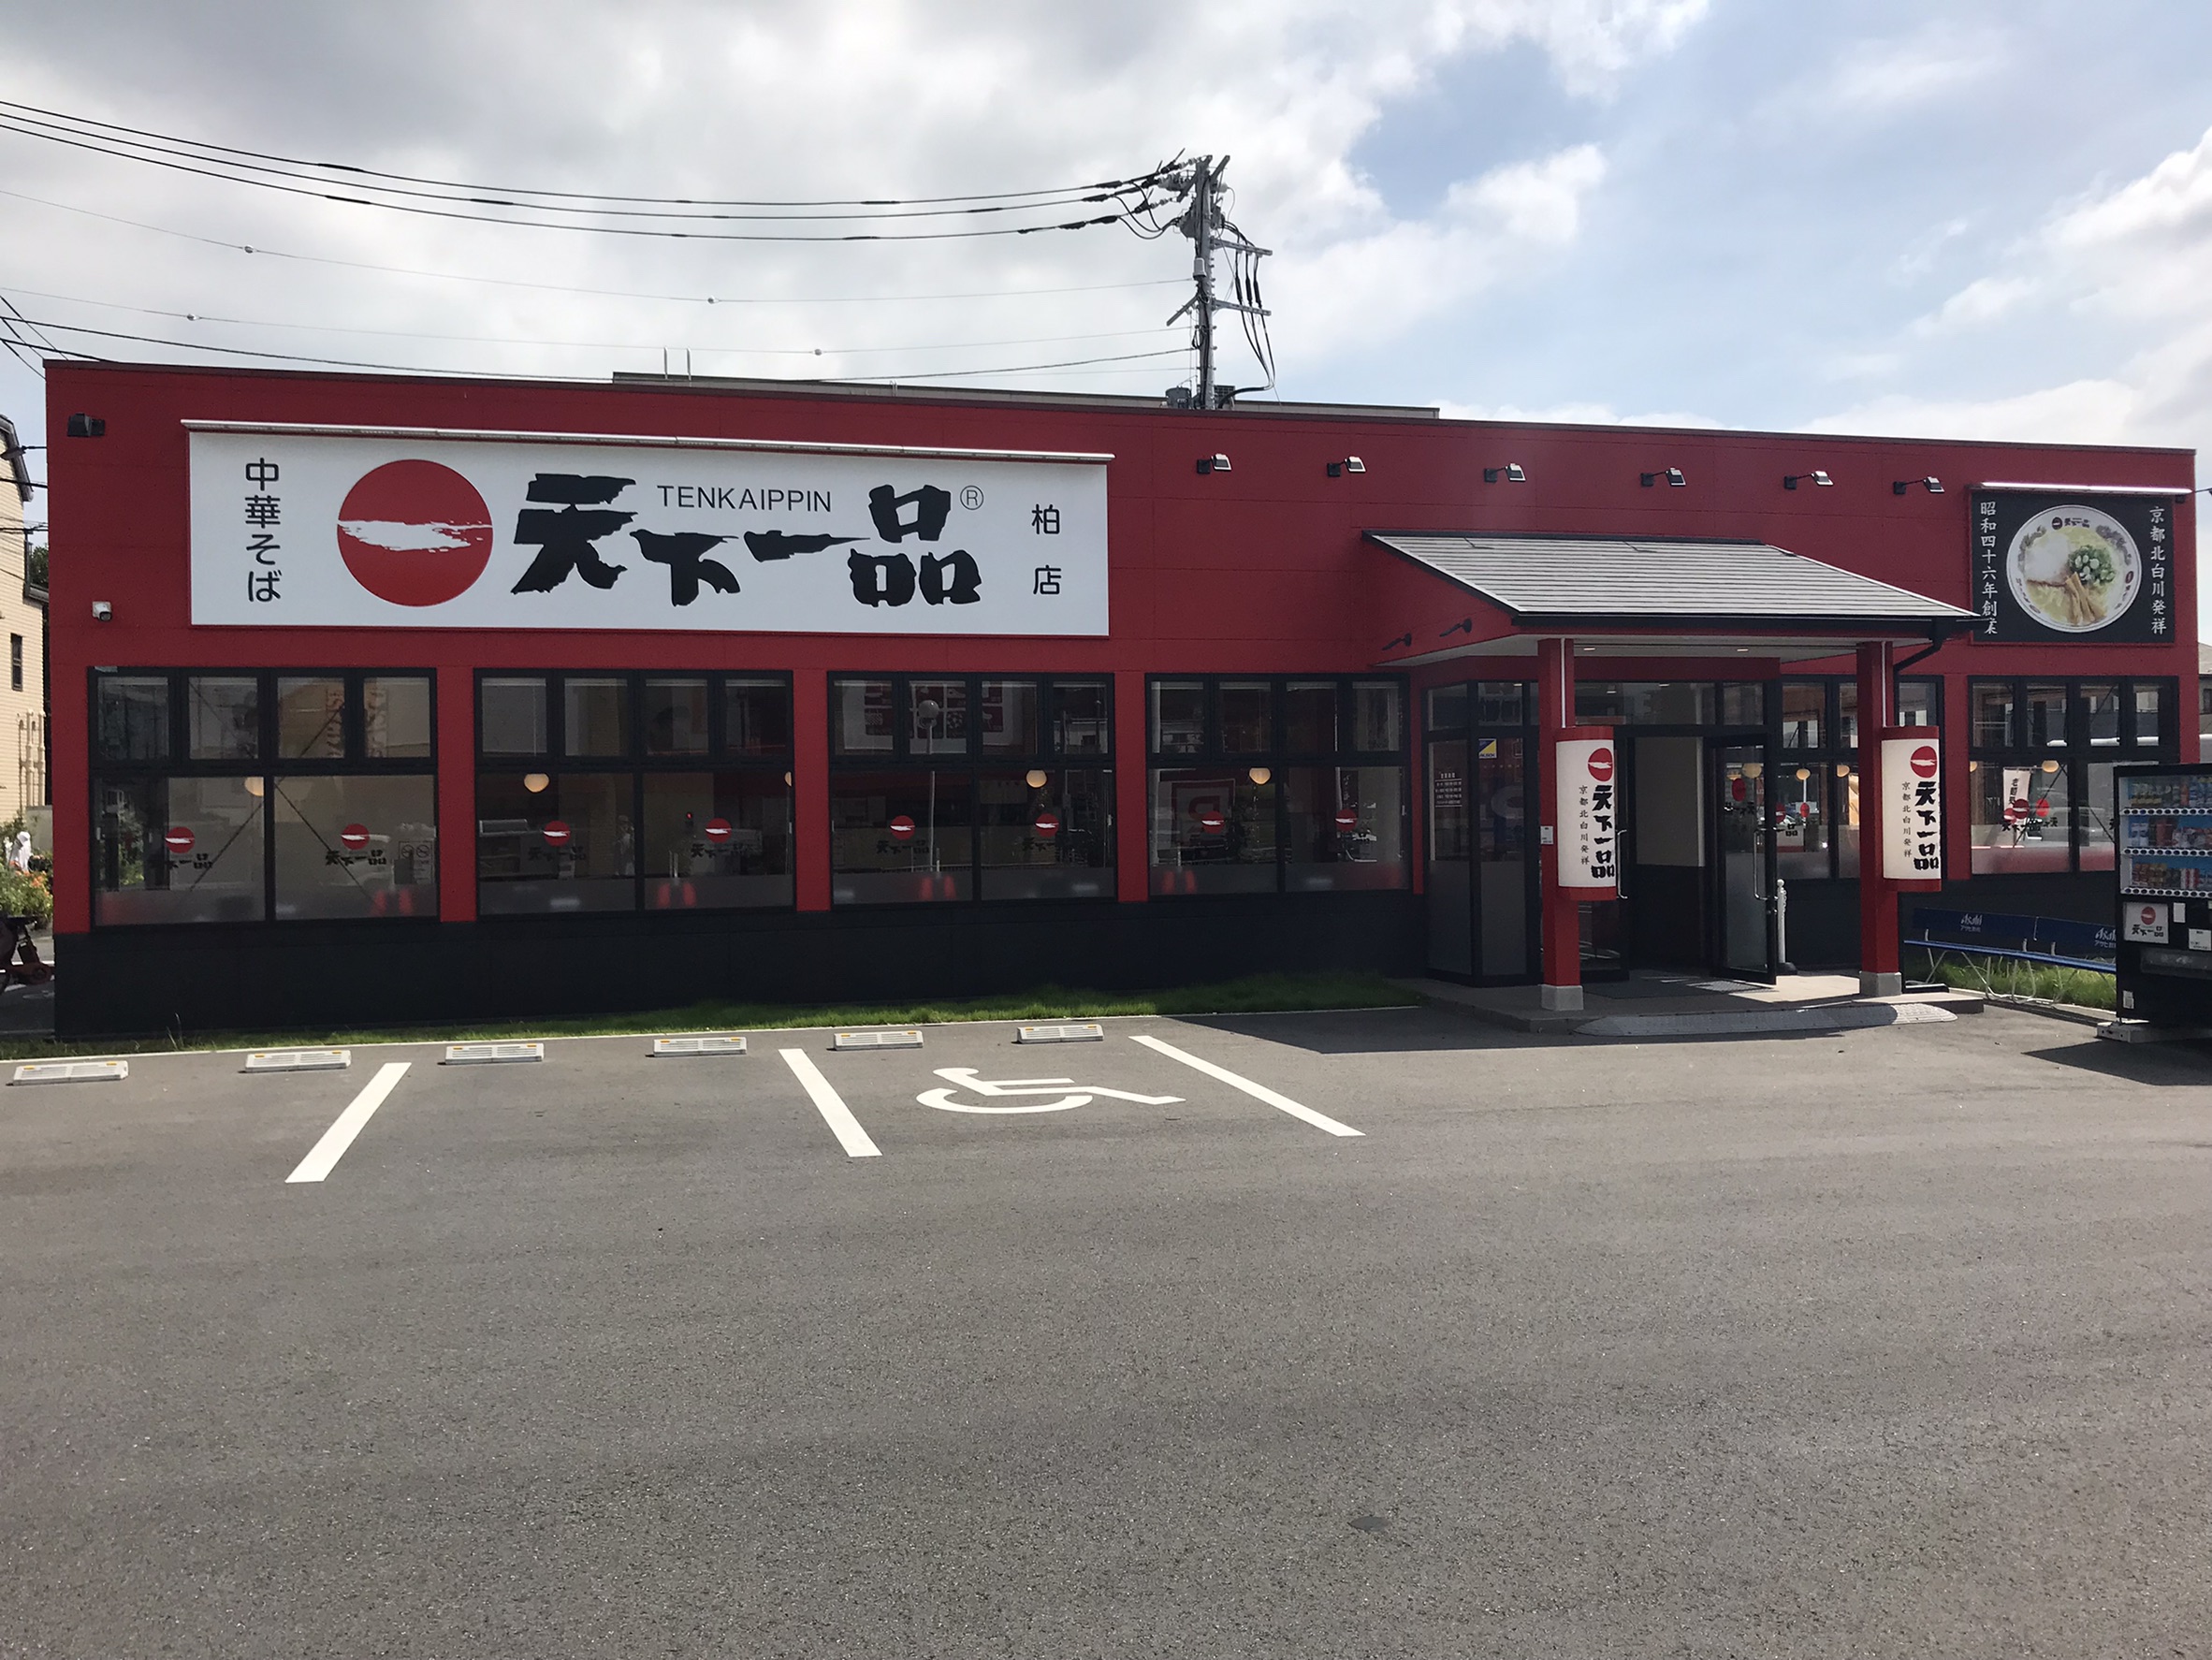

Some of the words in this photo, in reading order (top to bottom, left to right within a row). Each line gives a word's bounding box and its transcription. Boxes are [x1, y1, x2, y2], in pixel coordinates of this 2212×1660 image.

[244, 457, 283, 603] 中華そば
[511, 473, 982, 607] 天下一品
[657, 485, 831, 513] TENKAIPPIN
[1031, 503, 1062, 595] 柏店
[2149, 505, 2167, 634] 京都北白川発祥
[1579, 785, 1590, 866] 京都北白川発祥
[1592, 784, 1615, 879] 天下一品
[1901, 780, 1912, 858] 京都北白川発祥
[1914, 780, 1939, 871] 天下一品
[2132, 924, 2164, 938] 天下一品
